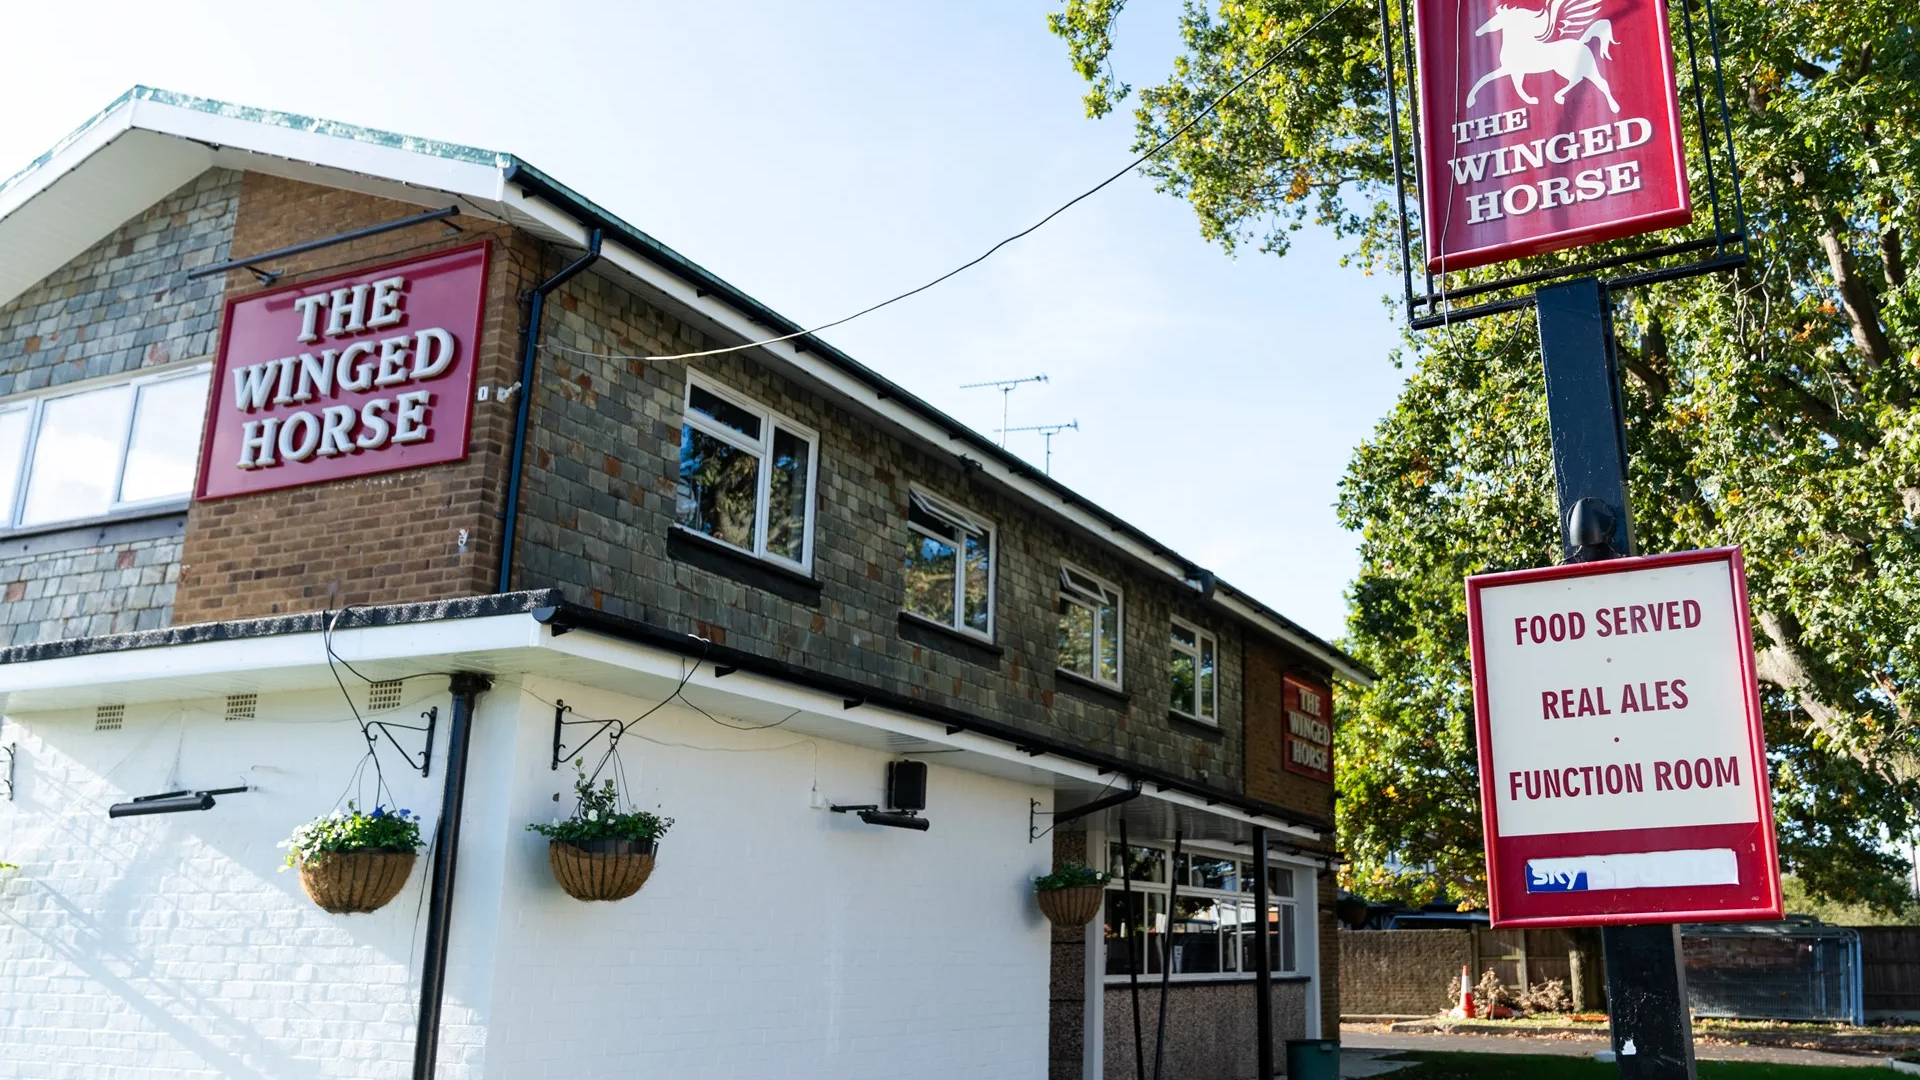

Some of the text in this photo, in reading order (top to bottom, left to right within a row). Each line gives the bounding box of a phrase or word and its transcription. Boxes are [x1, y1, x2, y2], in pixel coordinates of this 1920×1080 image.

[1452, 107, 1528, 144] THE
[1448, 117, 1653, 185] WINGED
[1466, 161, 1641, 225] HORSE
[294, 276, 404, 342] THE
[233, 327, 455, 412] WINGED
[237, 391, 430, 469] HORSE
[1514, 599, 1702, 645] FOOD SERVED
[1299, 688, 1322, 716] THE
[1541, 679, 1689, 720] REAL ALES
[1288, 710, 1331, 747] WINGED
[1292, 739, 1328, 773] HORSE
[1509, 756, 1740, 801] FUNCTION ROOM
